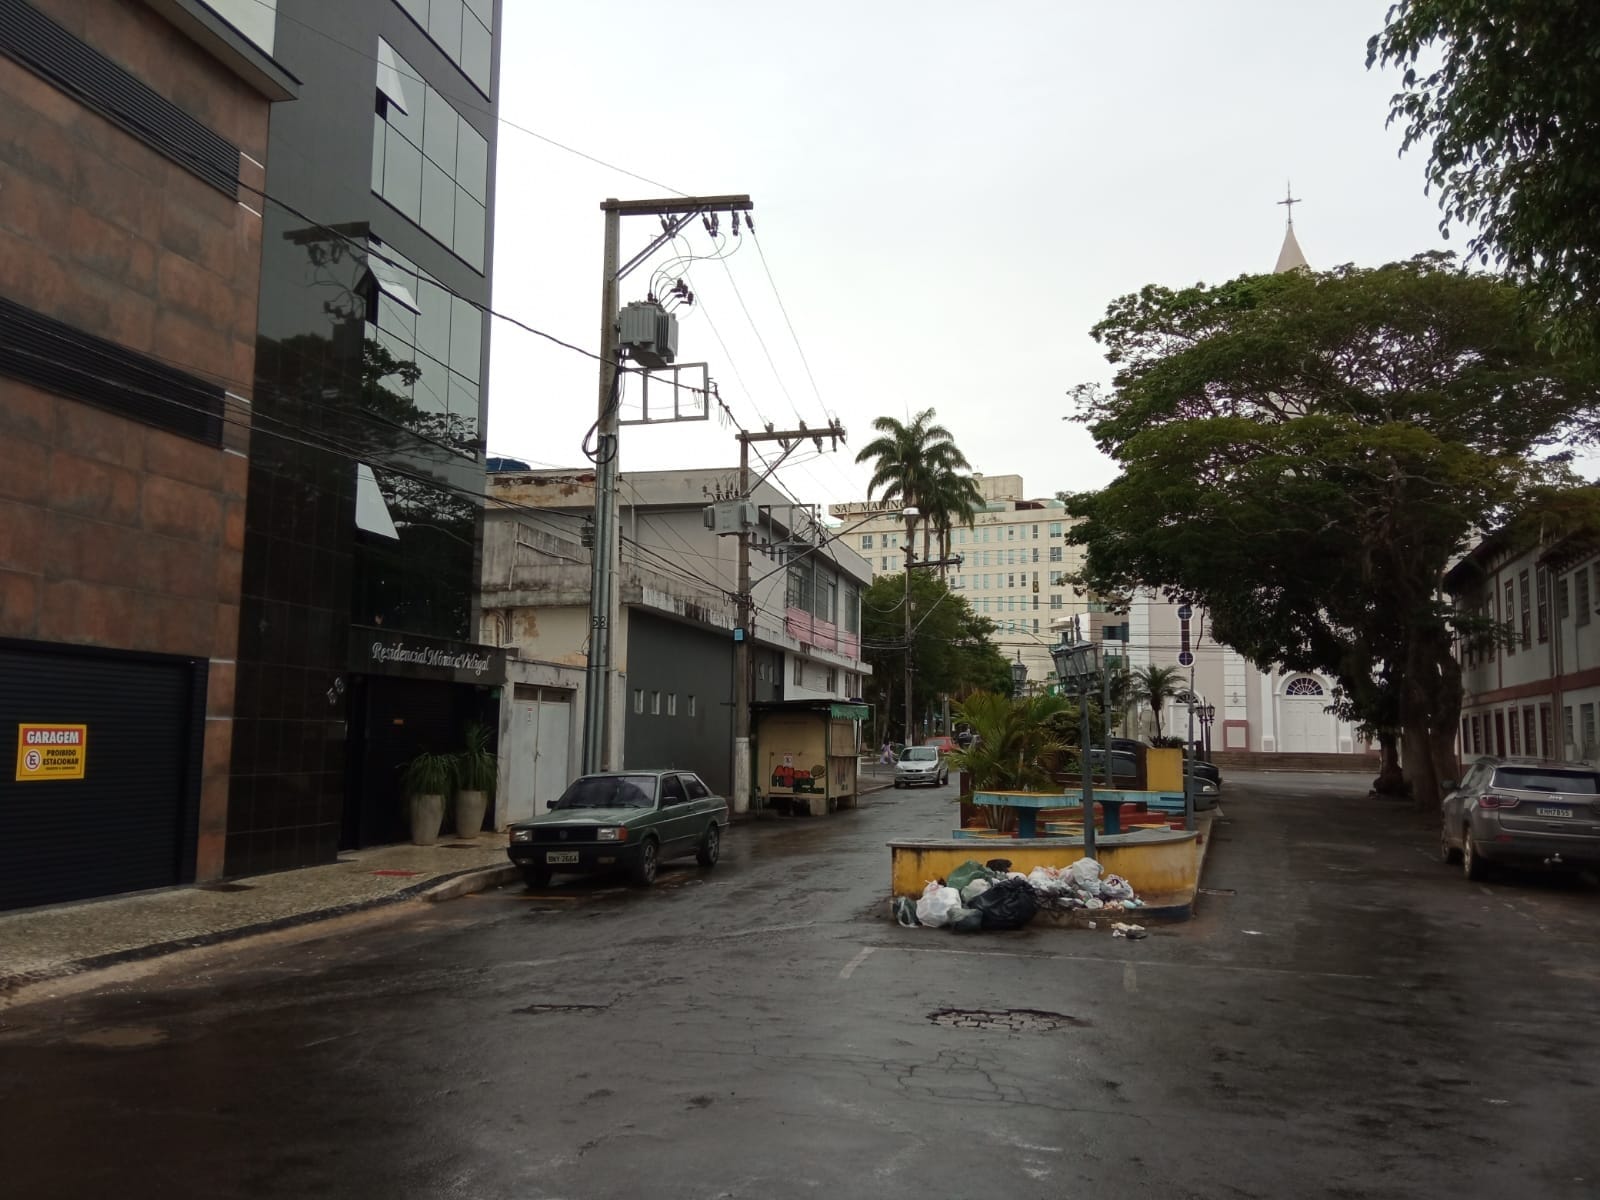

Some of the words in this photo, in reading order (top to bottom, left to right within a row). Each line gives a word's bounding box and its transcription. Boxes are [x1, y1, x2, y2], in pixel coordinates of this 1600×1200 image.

[372, 642, 430, 663] Residencial
[27, 730, 79, 744] GARAGEM
[43, 758, 79, 766] ESTACIONAR
